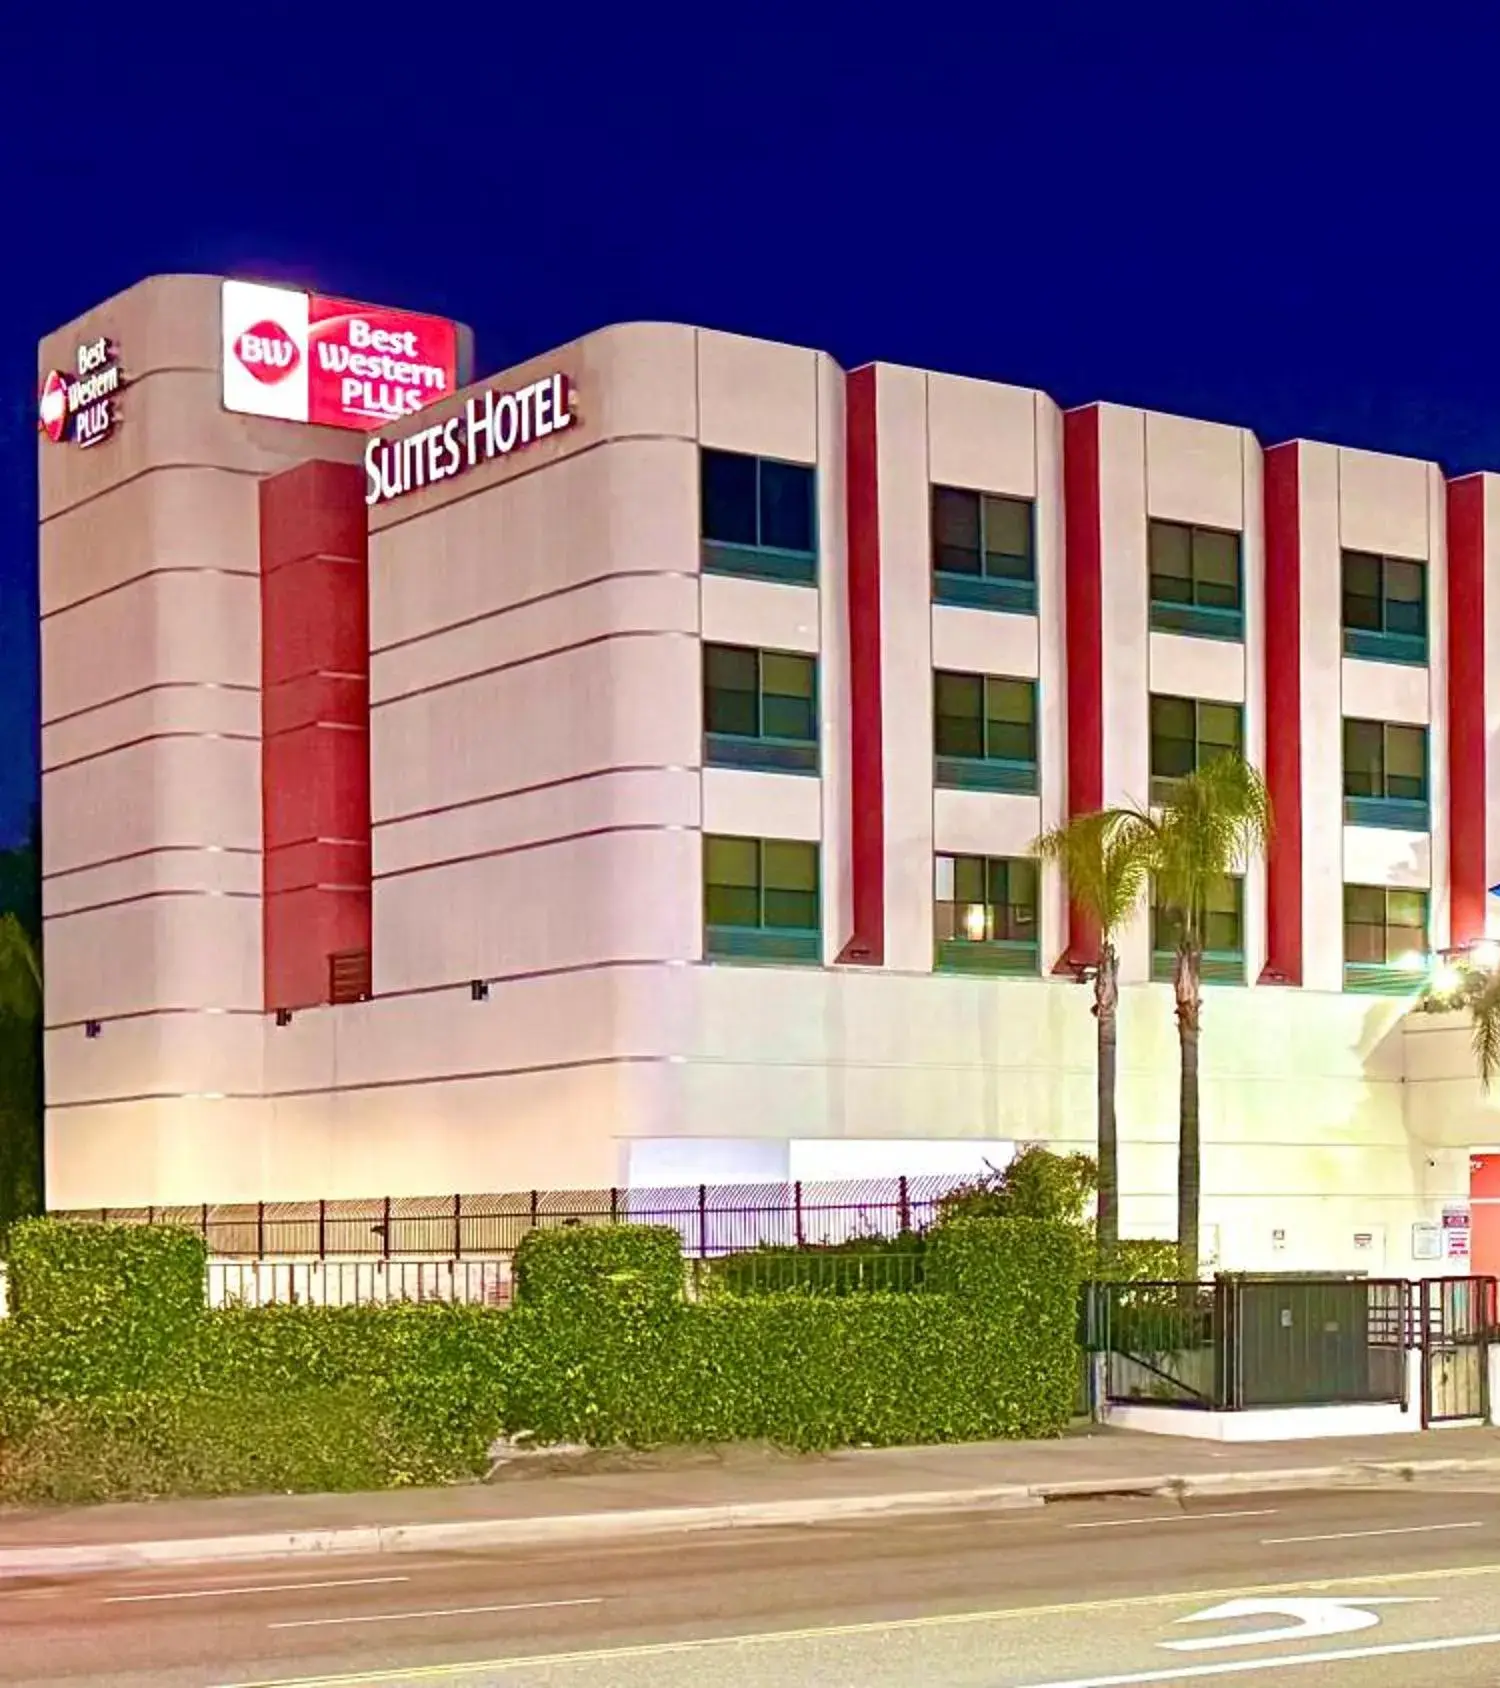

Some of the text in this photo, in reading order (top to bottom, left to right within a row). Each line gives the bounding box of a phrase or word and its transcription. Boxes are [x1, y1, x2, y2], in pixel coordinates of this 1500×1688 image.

[79, 337, 106, 375] Best
[240, 334, 292, 367] BW
[349, 319, 417, 357] Best
[317, 341, 446, 390] Western
[68, 367, 118, 413] Western
[341, 378, 424, 412] PLUS
[77, 400, 108, 442] PLUS
[365, 373, 570, 505] SUITES HOTEL
